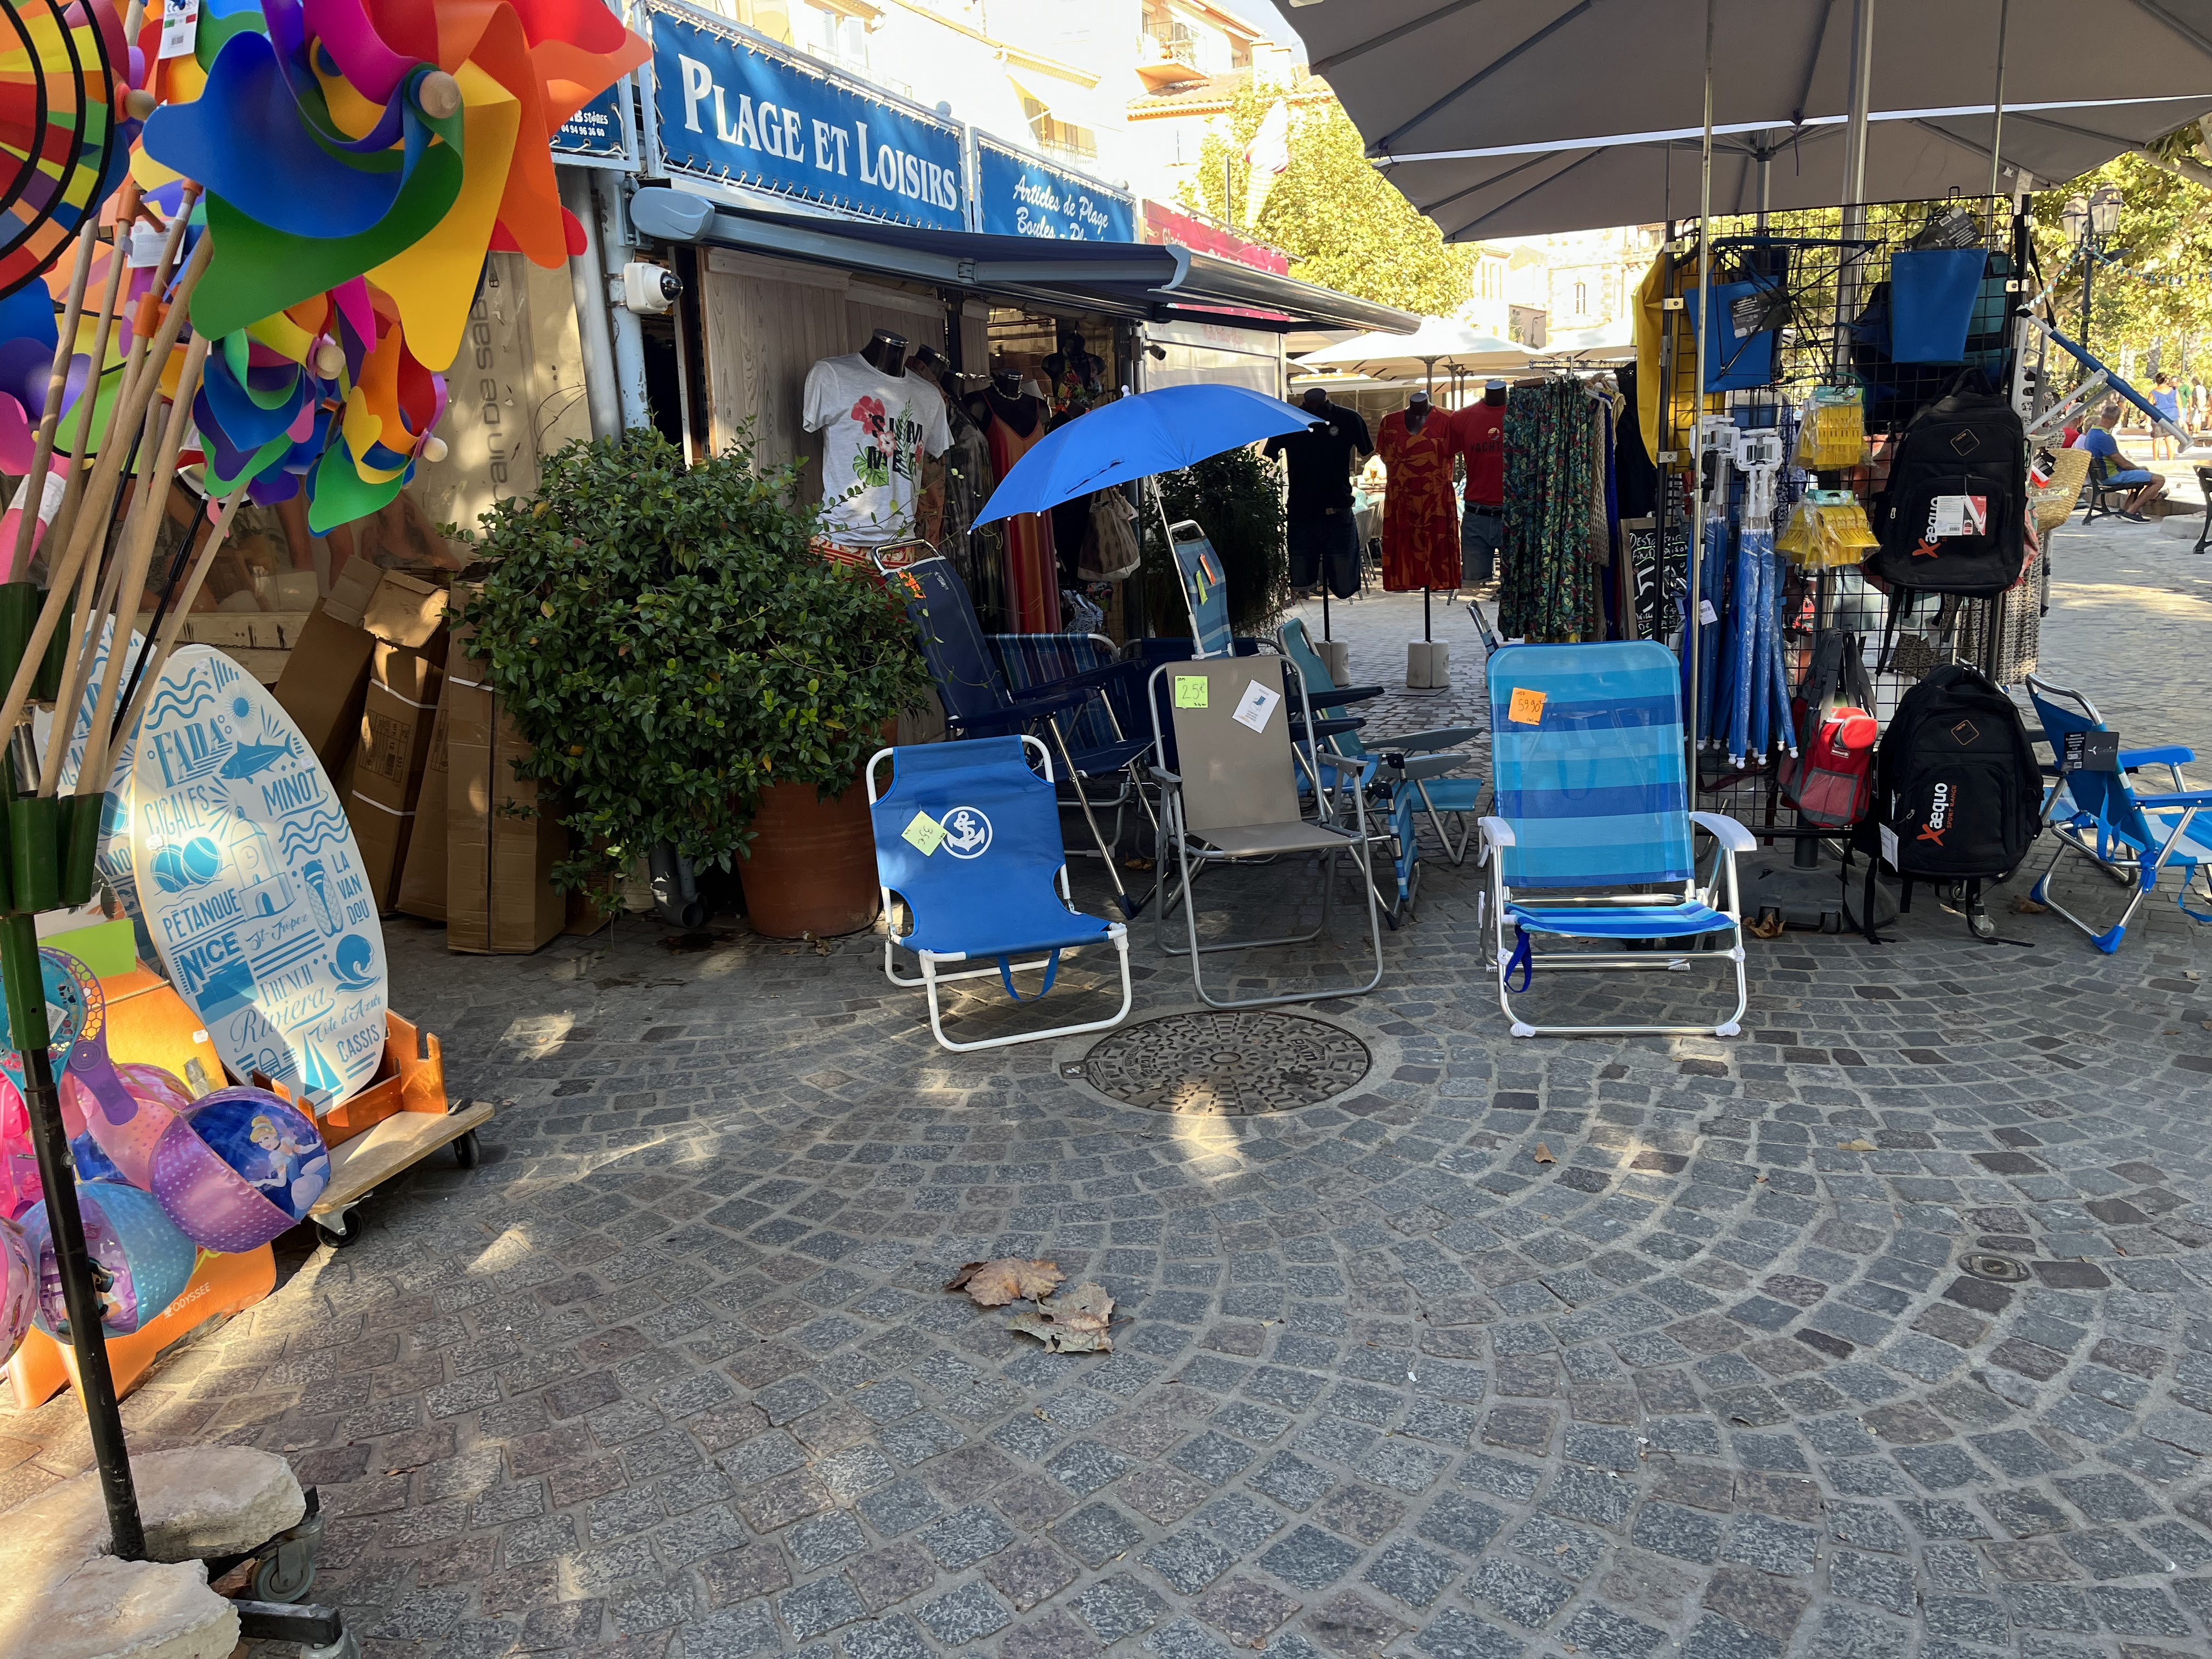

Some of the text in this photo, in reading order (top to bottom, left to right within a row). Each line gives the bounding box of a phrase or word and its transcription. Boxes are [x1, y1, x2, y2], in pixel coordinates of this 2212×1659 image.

[561, 124, 569, 133] 04
[569, 125, 578, 134] 94
[678, 53, 805, 163] PLAGE
[812, 119, 849, 176] ET
[855, 120, 957, 211] LOISIRS
[1013, 174, 1060, 212] Articles
[1063, 194, 1075, 217] de
[1079, 196, 1109, 235] Plage
[1016, 206, 1056, 238] Boules
[152, 718, 228, 788] FADA
[144, 784, 210, 838] CIGALES
[261, 767, 319, 816] MINOT
[331, 851, 350, 873] LA
[337, 873, 363, 900] VAN
[346, 899, 370, 926] DOU
[179, 931, 242, 993] NICE
[259, 963, 314, 1007] FRENCH
[230, 986, 332, 1052] Riviera
[308, 994, 382, 1042] Côte d'Azur
[336, 1024, 380, 1063] CASSIS
[173, 1282, 211, 1311] ODYSSEE
